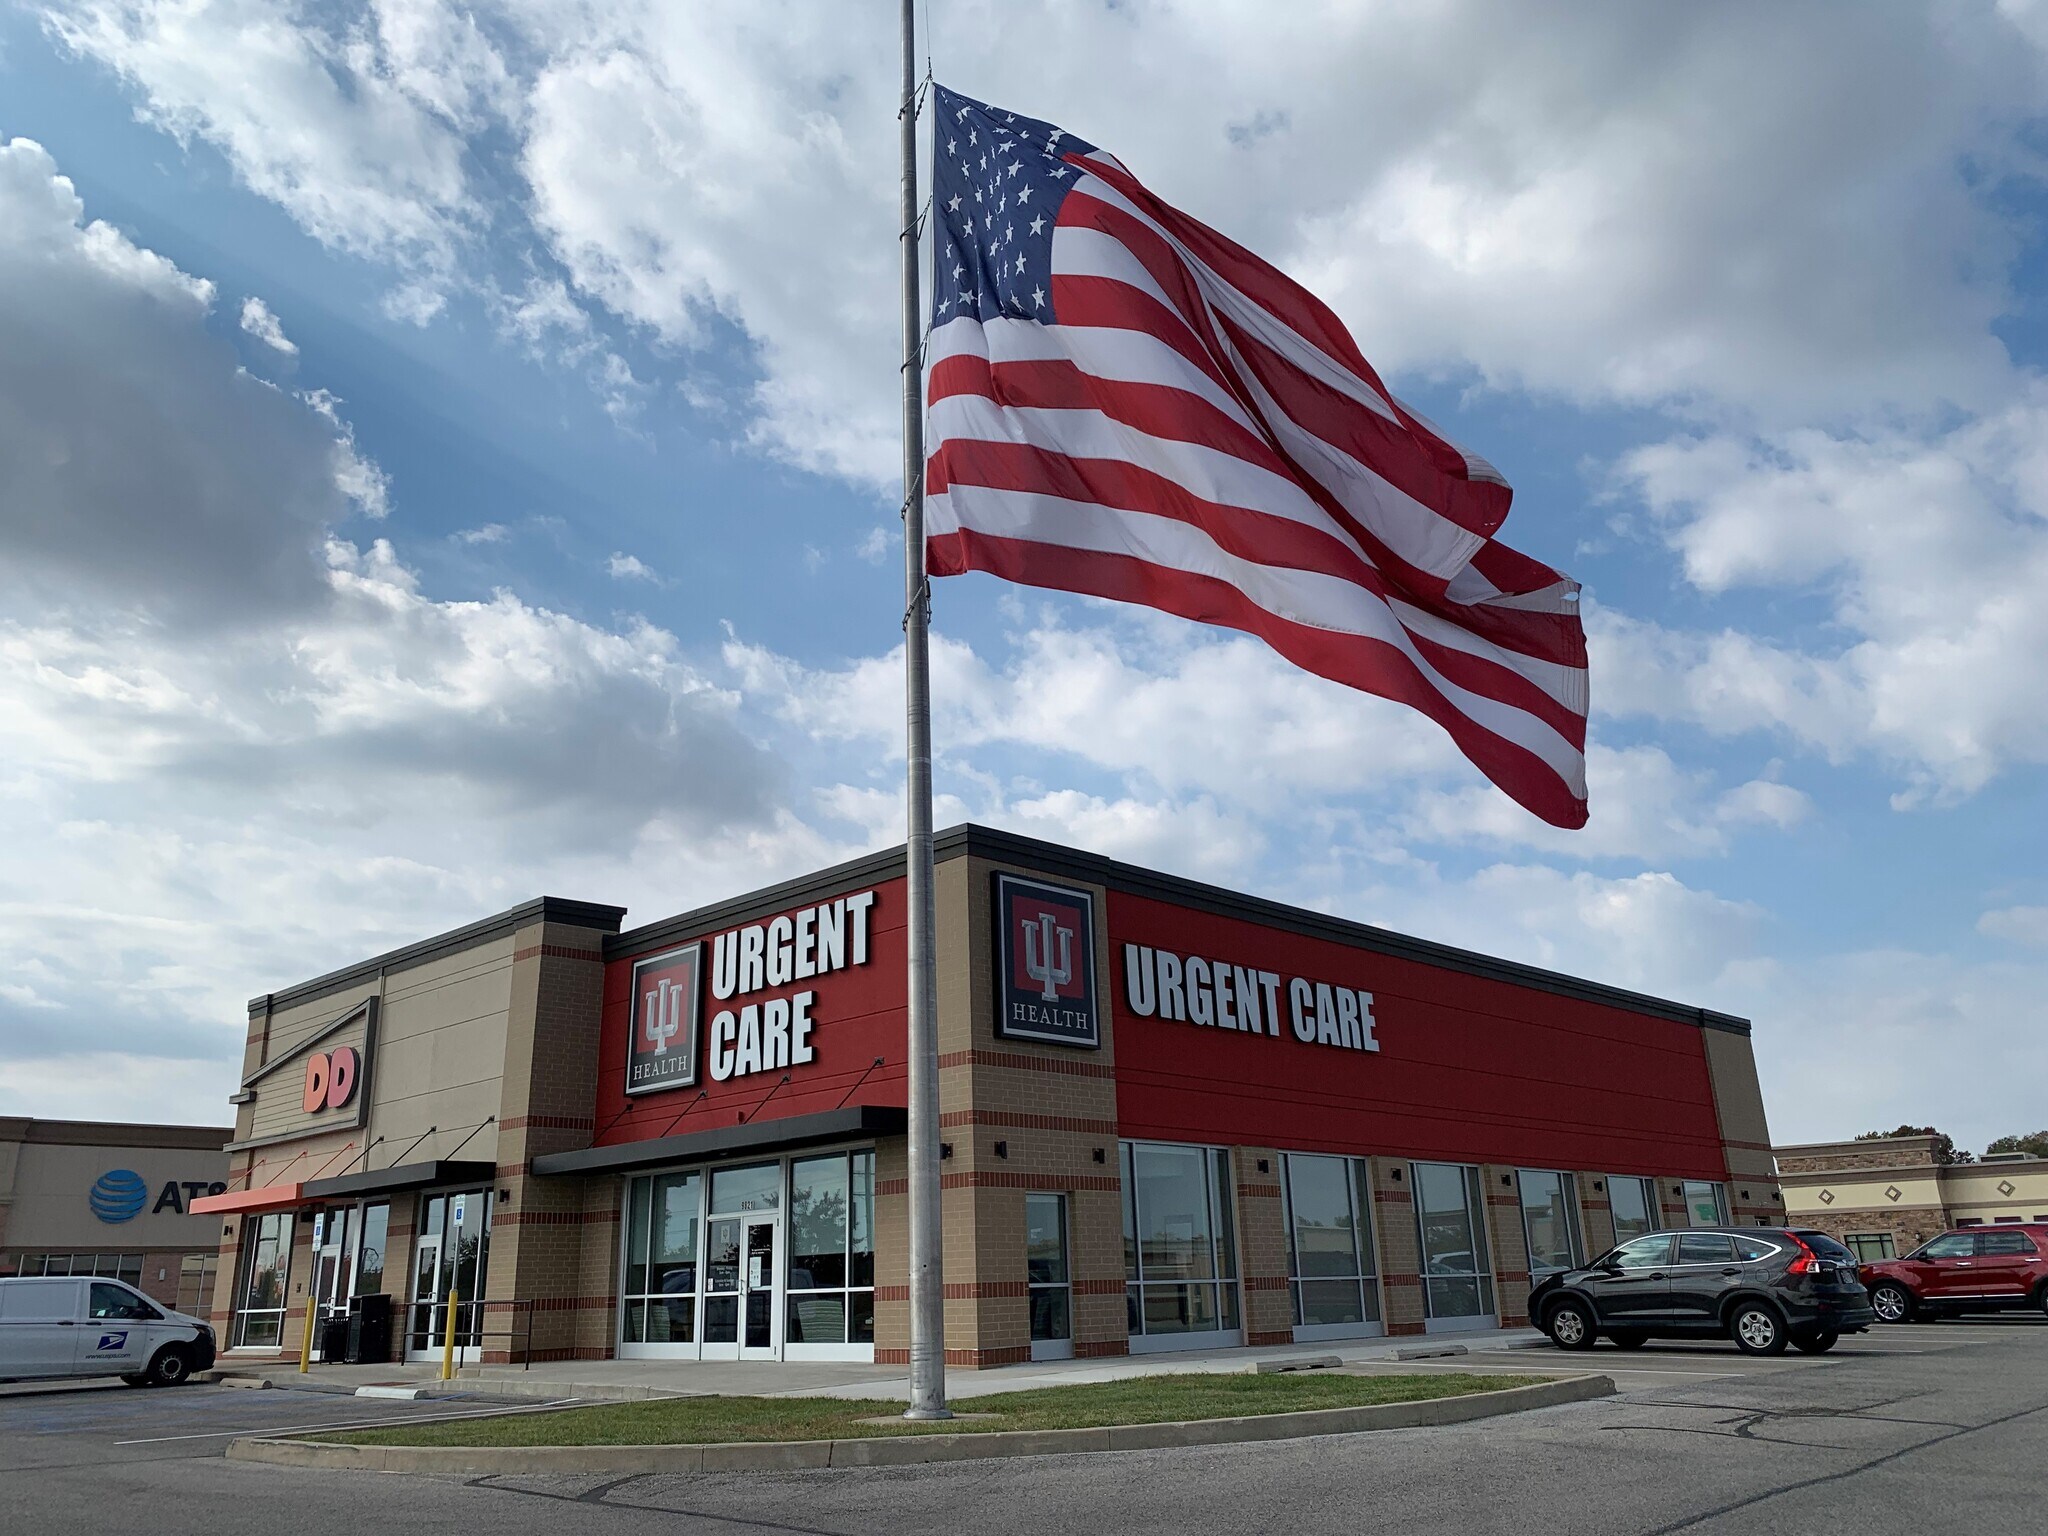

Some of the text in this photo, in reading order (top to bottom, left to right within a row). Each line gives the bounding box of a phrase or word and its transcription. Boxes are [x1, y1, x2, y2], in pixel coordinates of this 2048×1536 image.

[712, 890, 873, 1000] URGENT
[709, 990, 813, 1081] CARE
[1012, 1002, 1088, 1030] HEALTH
[1125, 943, 1380, 1052] URGENT CARE
[303, 1046, 357, 1113] DD
[633, 1055, 688, 1081] HEALTH
